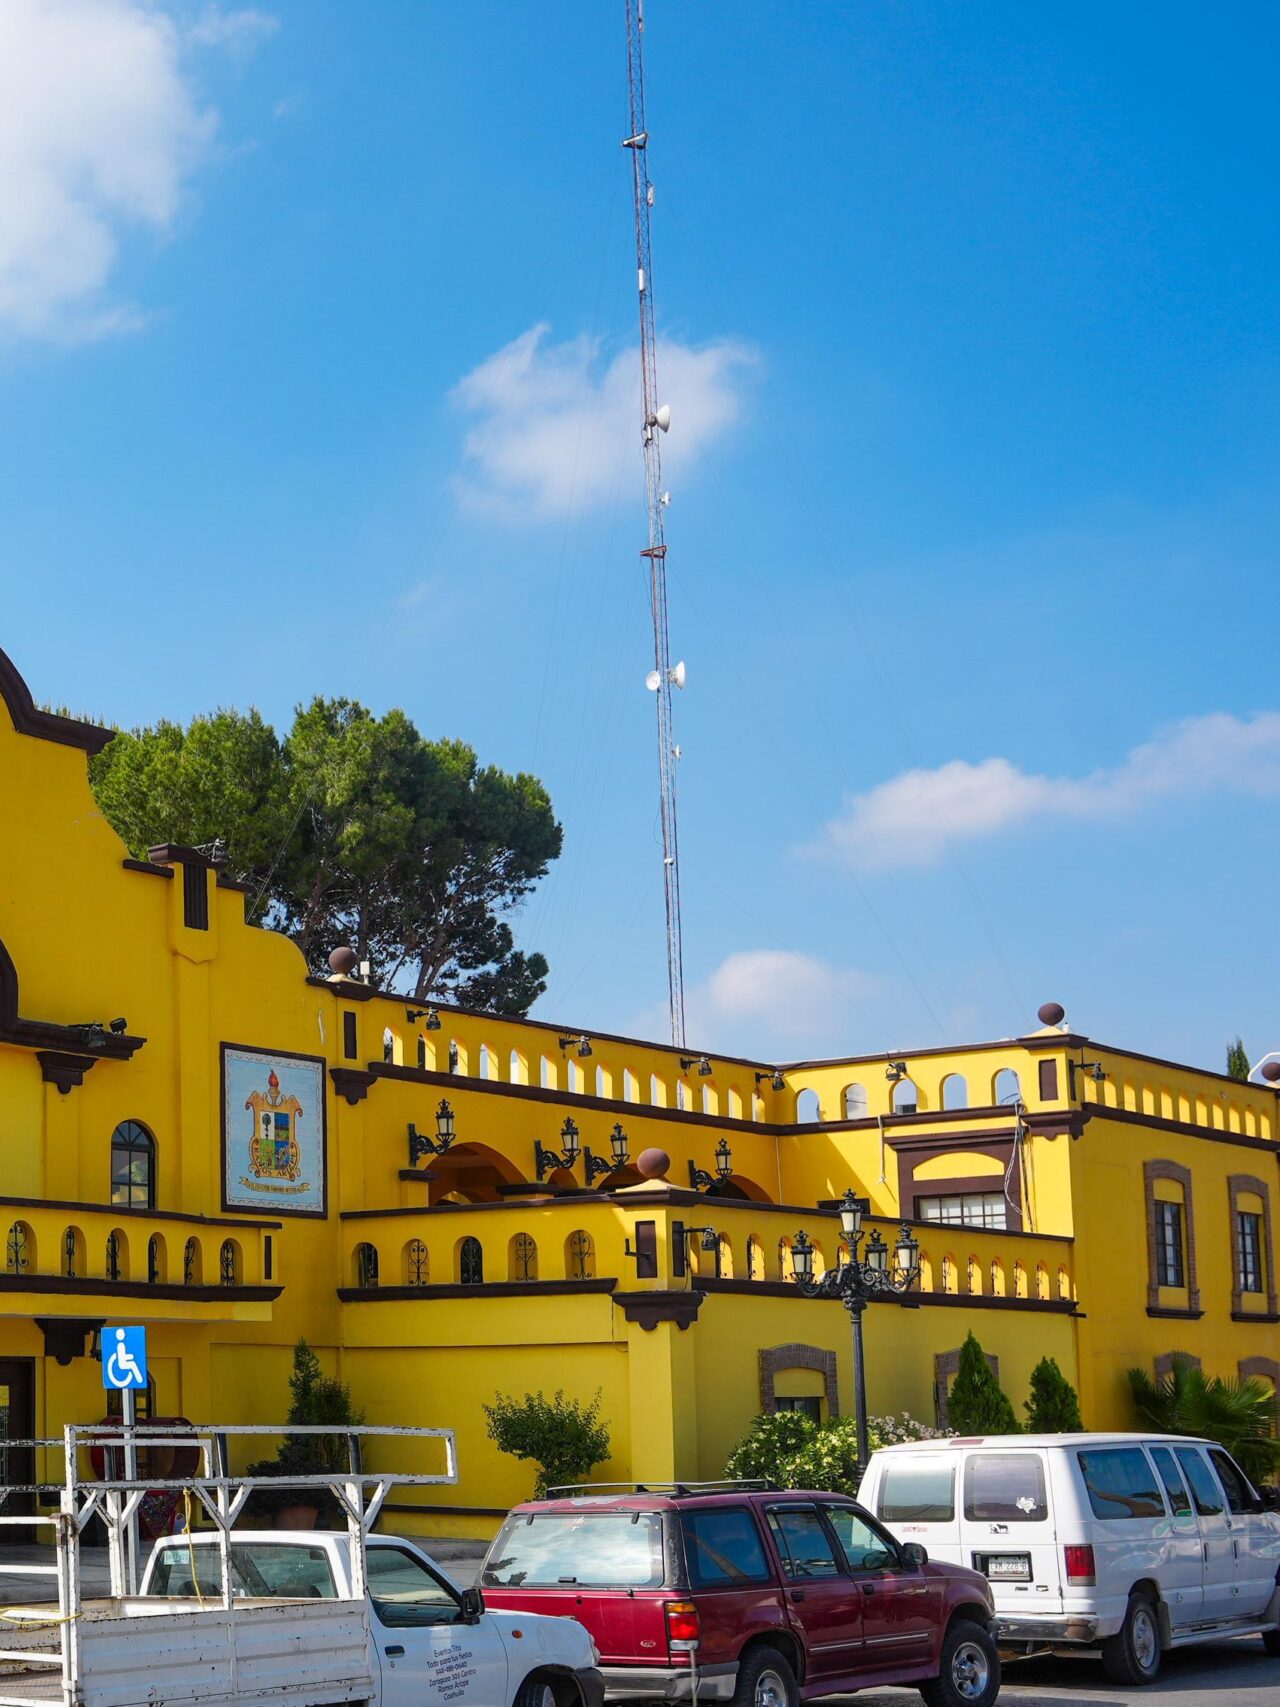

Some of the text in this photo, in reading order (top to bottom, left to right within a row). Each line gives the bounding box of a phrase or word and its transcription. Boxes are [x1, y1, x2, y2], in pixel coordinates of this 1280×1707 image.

[433, 1648, 452, 1658] Eventos
[426, 1660, 439, 1669] Todo
[439, 1657, 451, 1666] para
[458, 1651, 473, 1660] fiestas
[429, 1676, 451, 1687] Zaragoza
[461, 1668, 476, 1677] Centro
[437, 1680, 469, 1693] Ramos Arizpe
[443, 1689, 465, 1701] Coahuila
